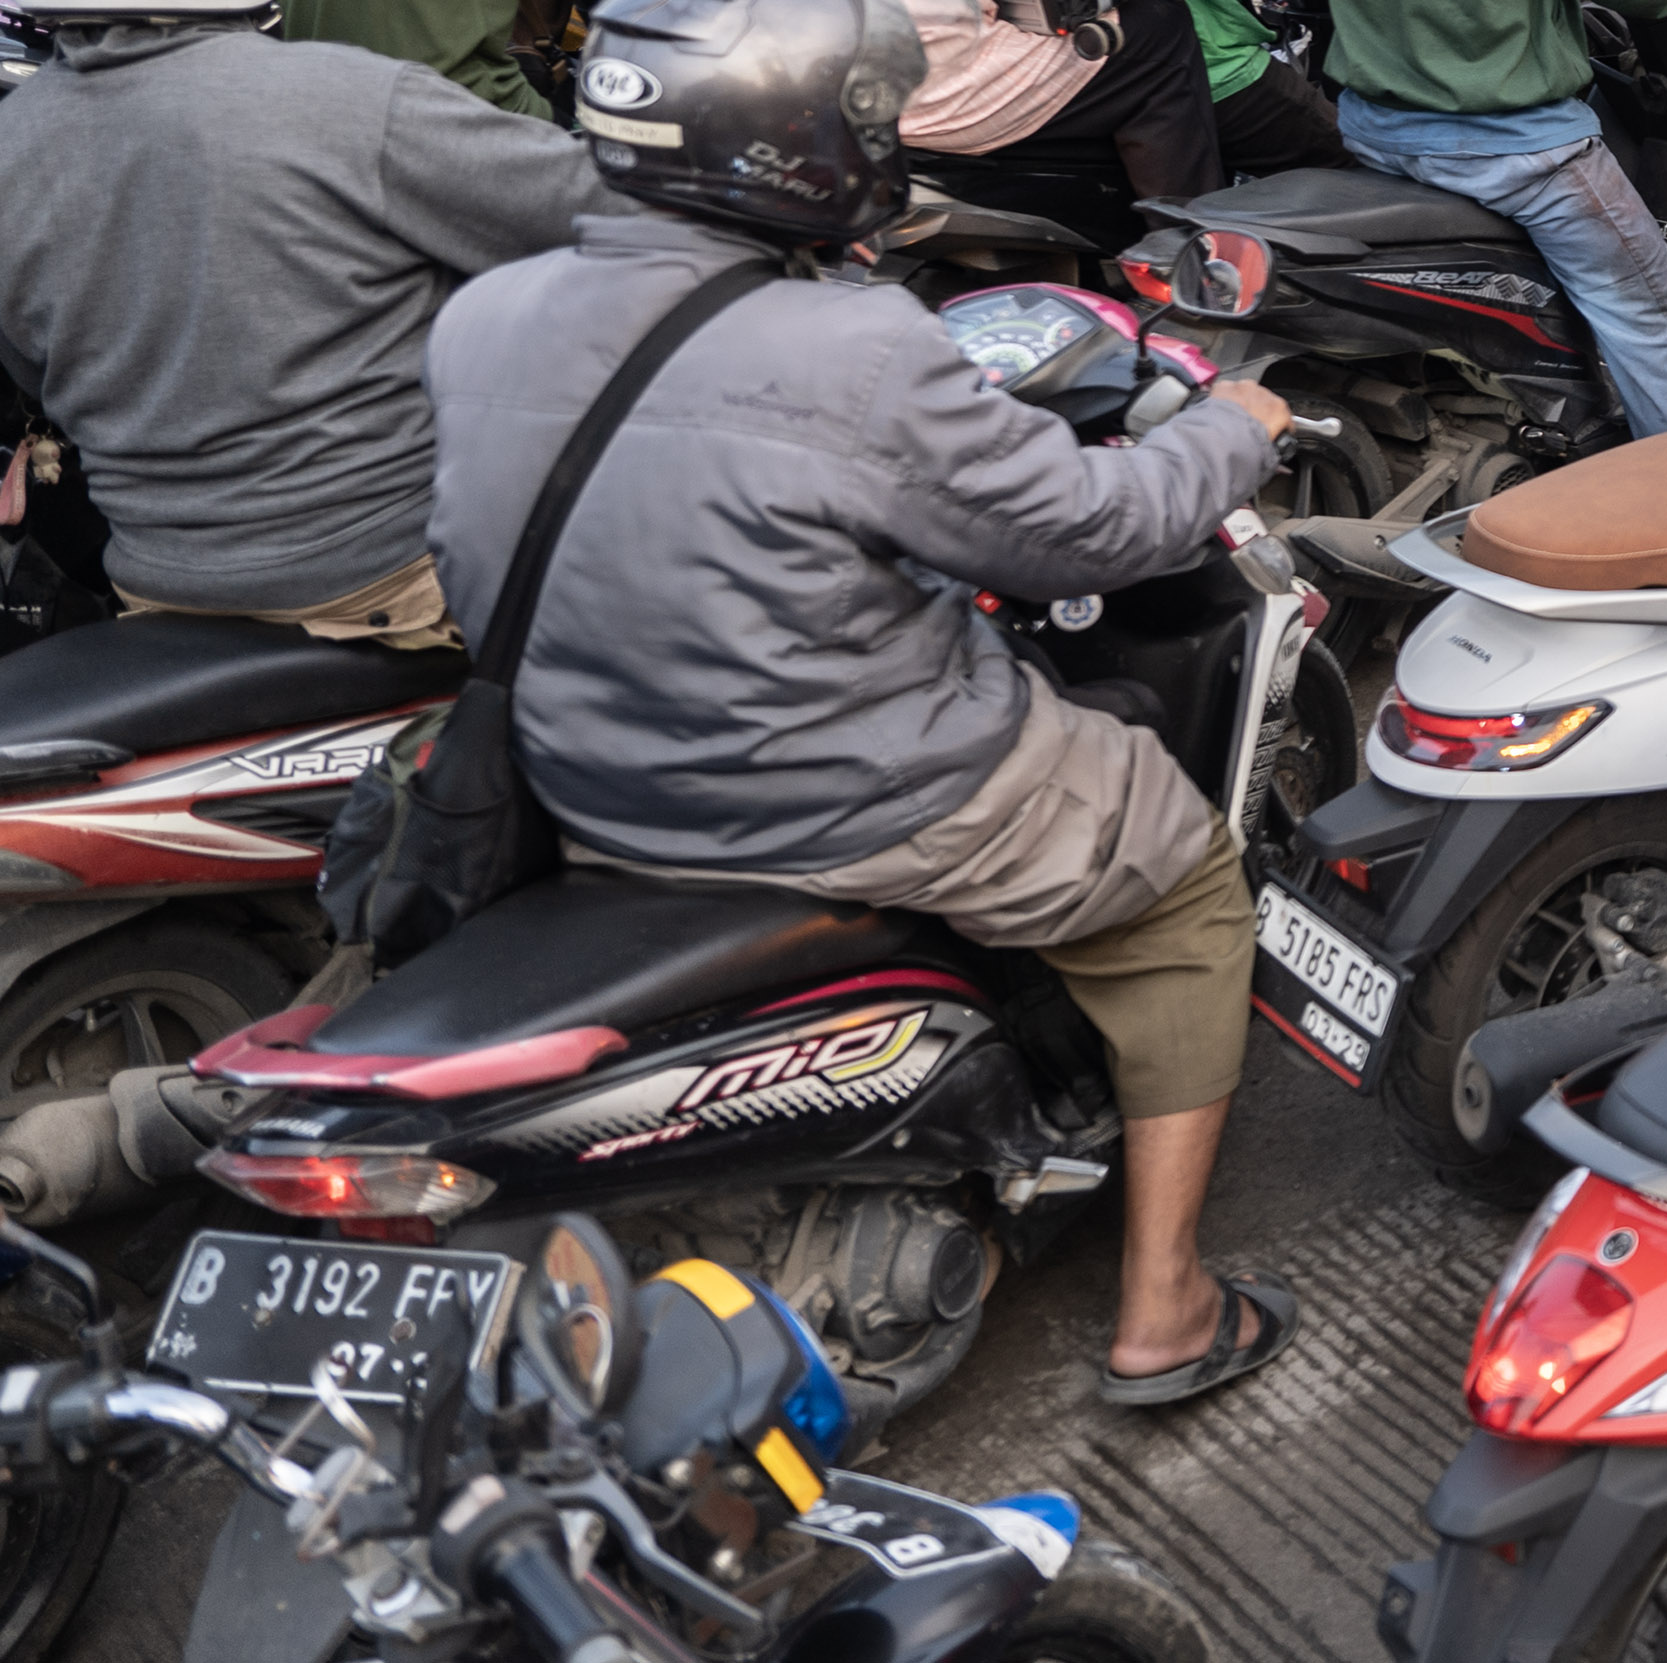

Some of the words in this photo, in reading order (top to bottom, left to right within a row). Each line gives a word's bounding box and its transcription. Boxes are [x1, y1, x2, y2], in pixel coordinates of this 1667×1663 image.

[1447, 634, 1494, 664] HONDA
[1279, 914, 1338, 984] 5185
[1341, 967, 1393, 1024] FRS
[179, 1247, 226, 1305] B
[255, 1253, 383, 1319] 3192
